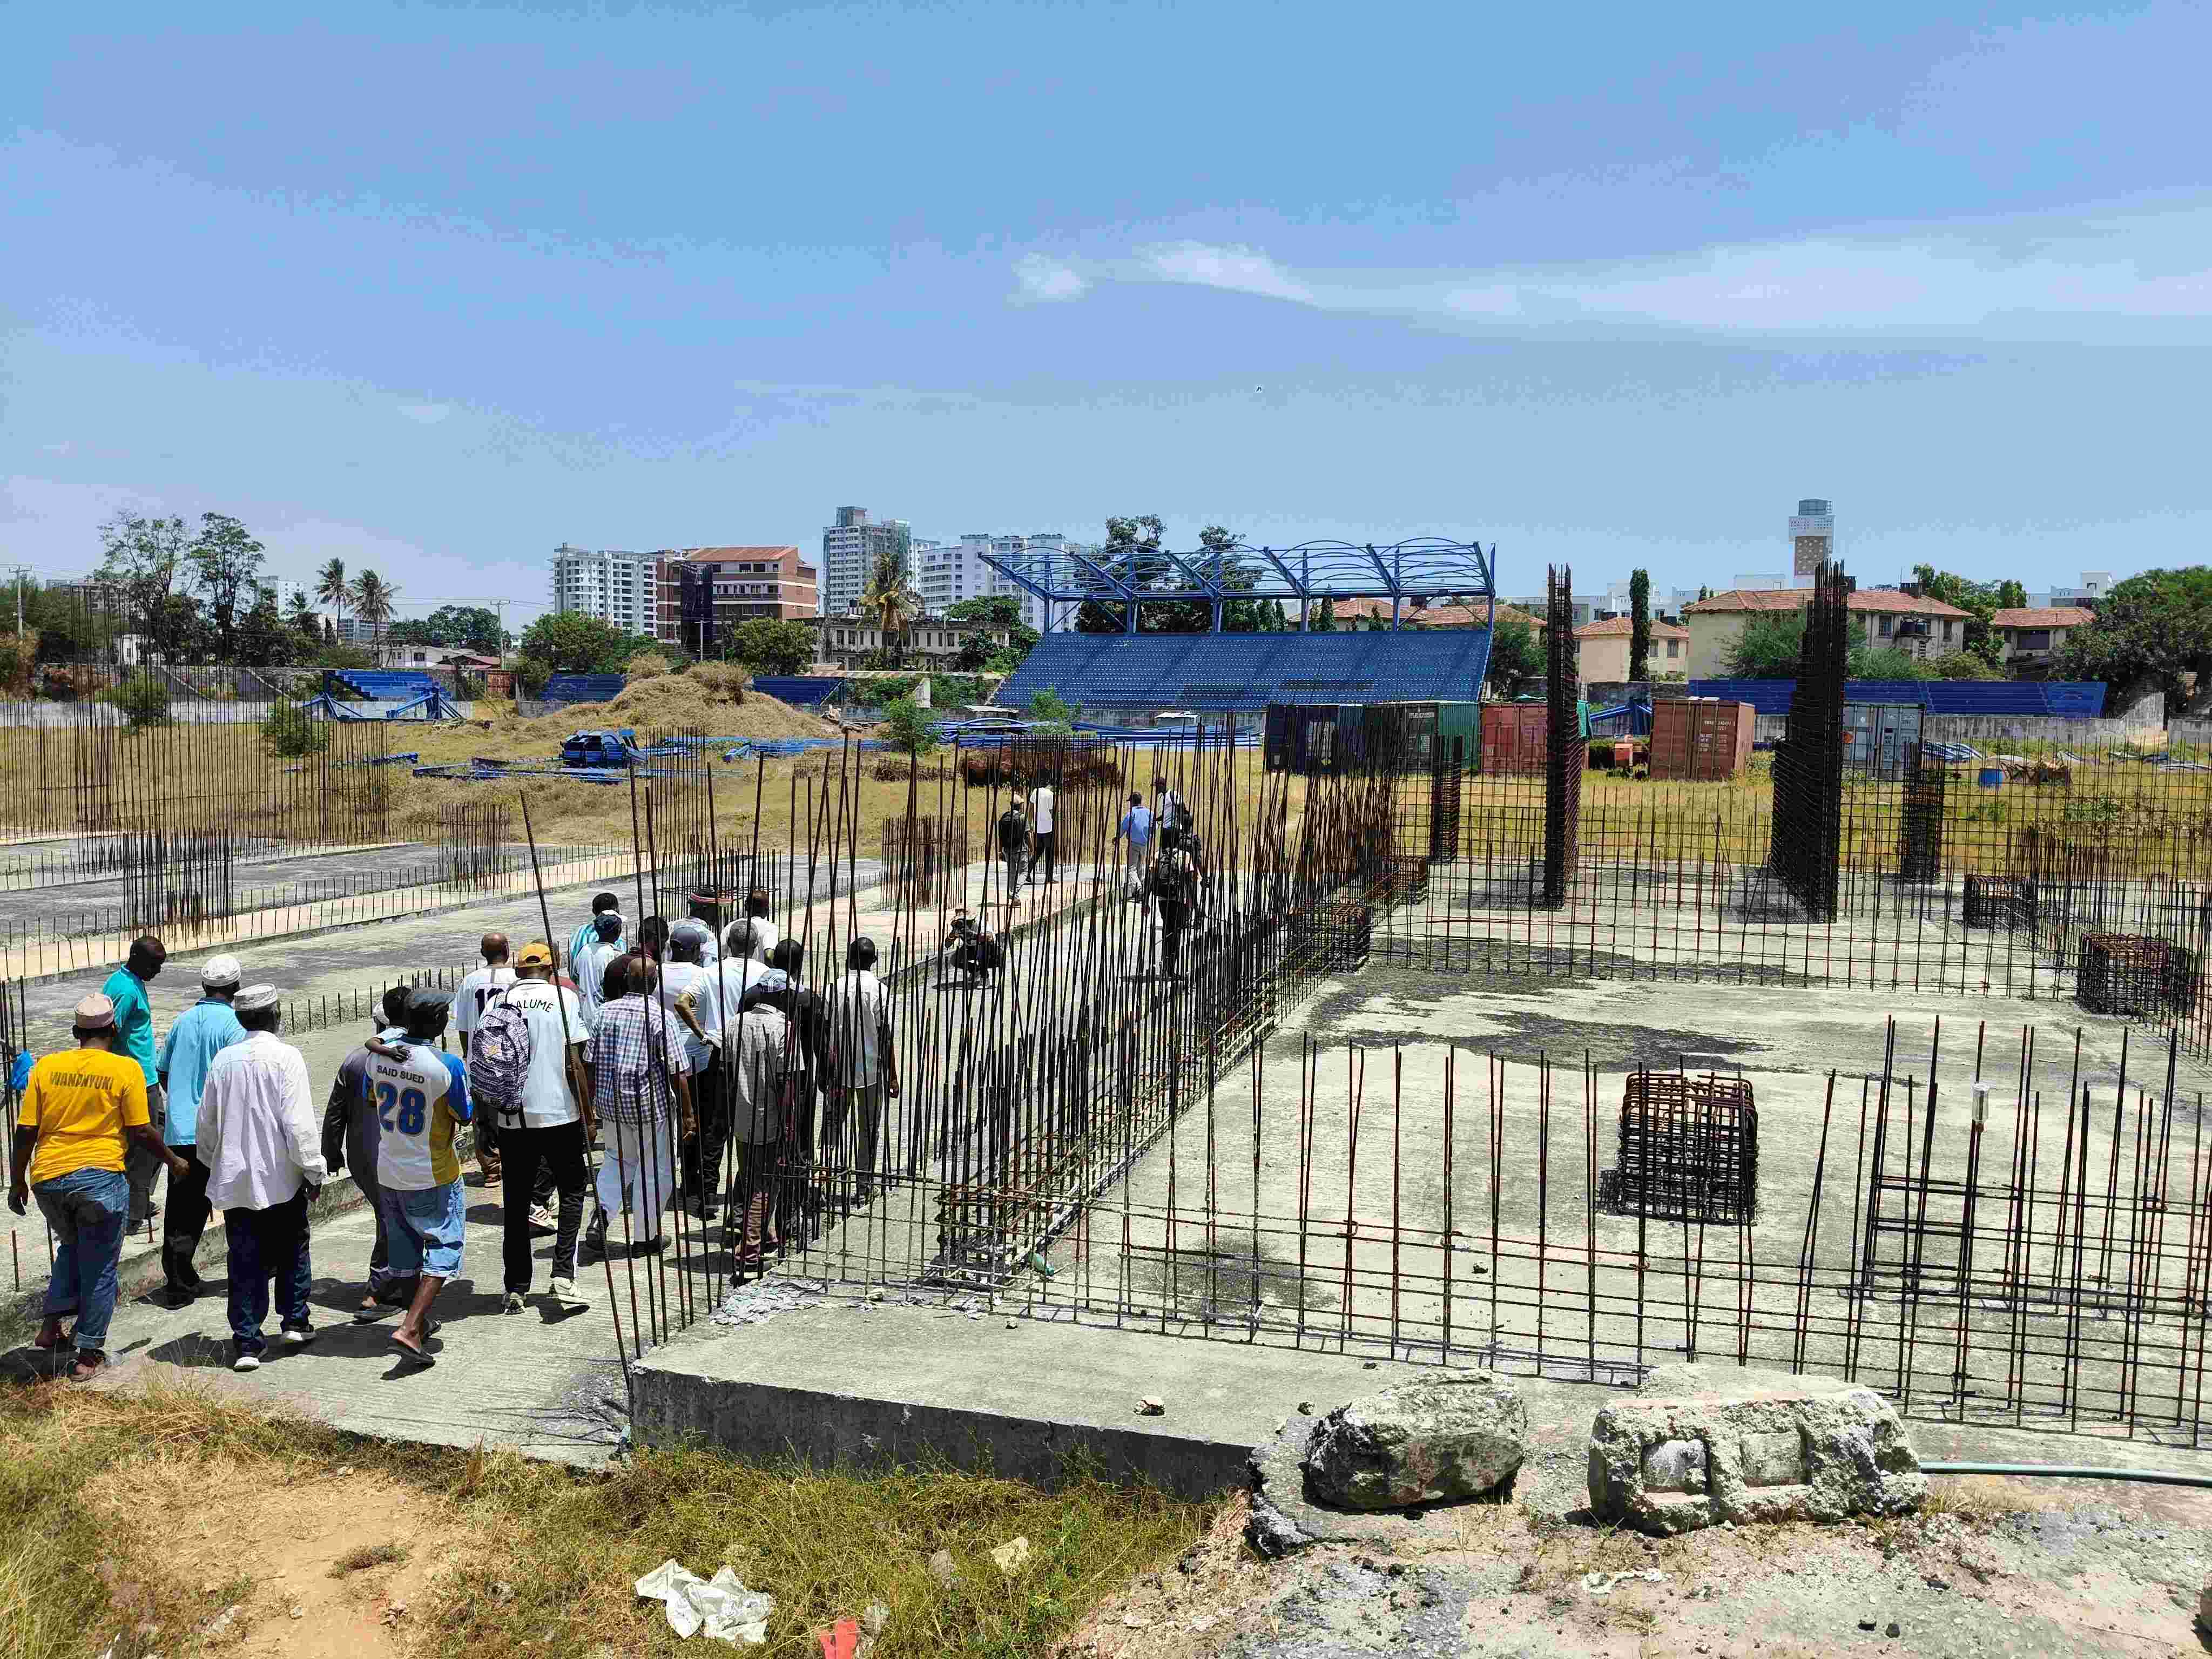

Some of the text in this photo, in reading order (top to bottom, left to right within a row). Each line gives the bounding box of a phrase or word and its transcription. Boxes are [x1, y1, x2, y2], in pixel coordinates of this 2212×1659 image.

[510, 999, 554, 1013] ALUME
[376, 1064, 425, 1084] SAID SUED
[375, 1080, 427, 1137] 28
